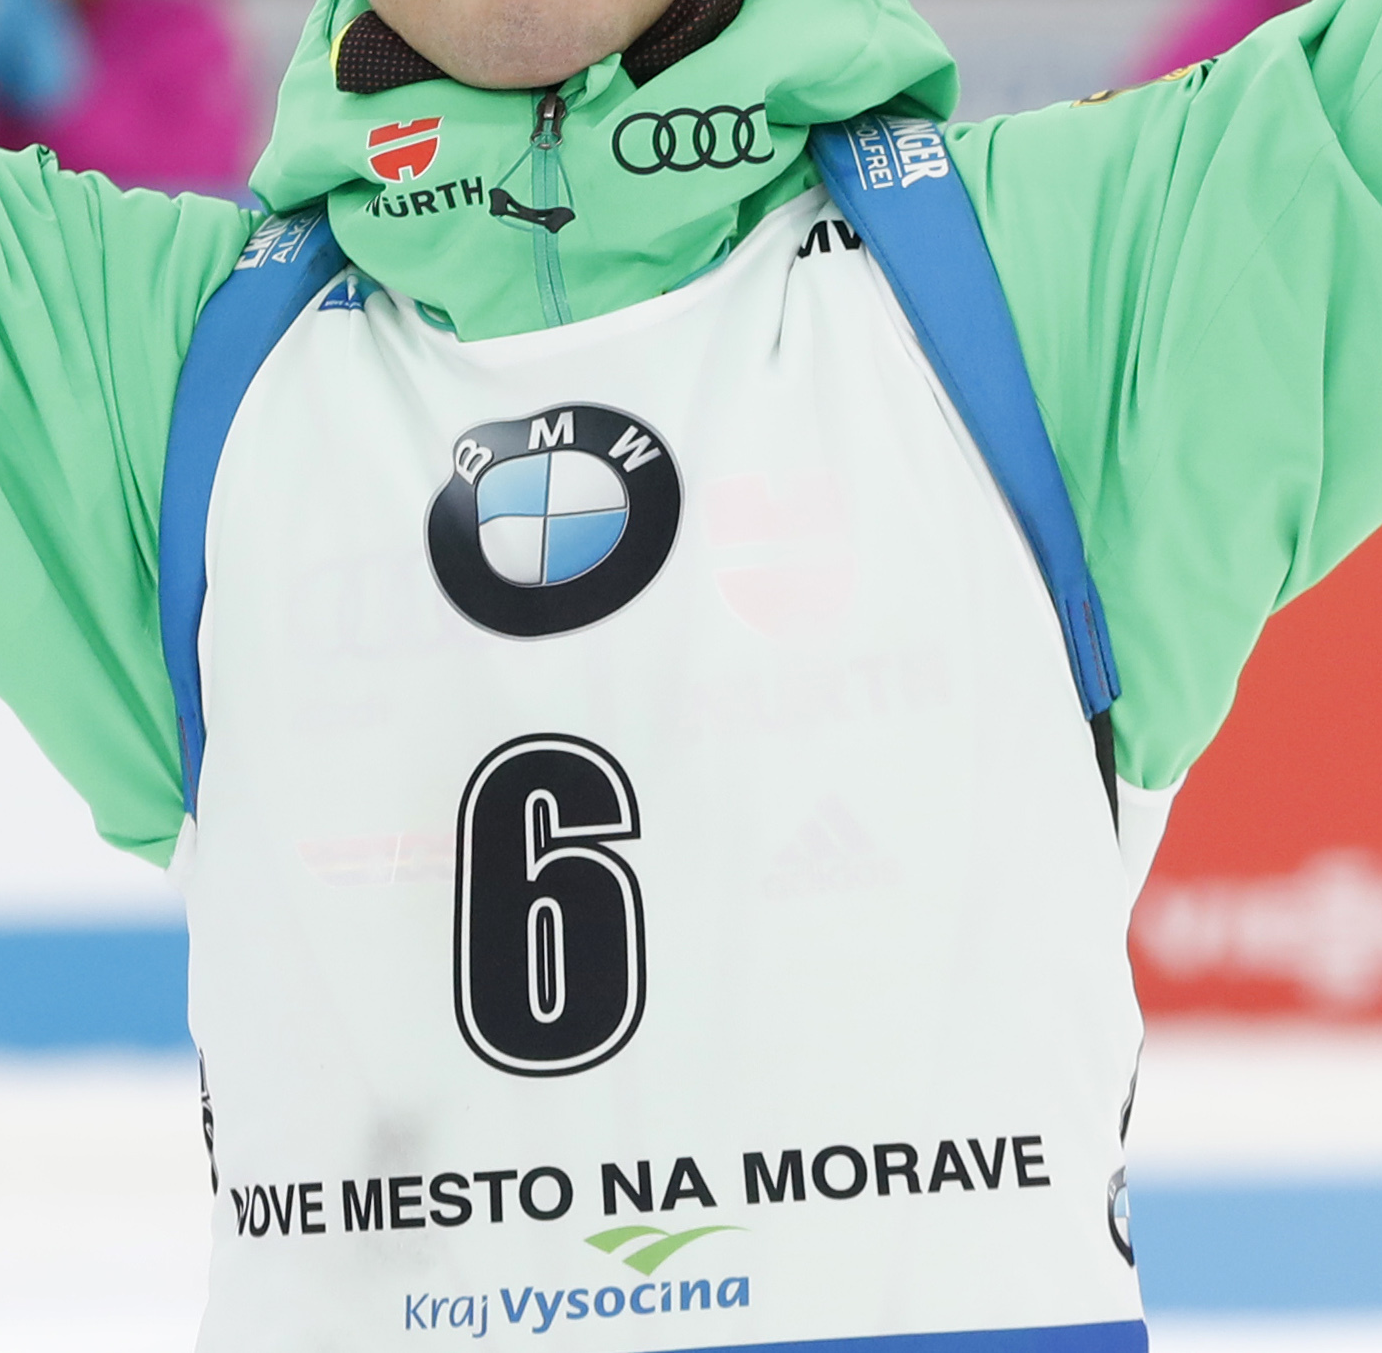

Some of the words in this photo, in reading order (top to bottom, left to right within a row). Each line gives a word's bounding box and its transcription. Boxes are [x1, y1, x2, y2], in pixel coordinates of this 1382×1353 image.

[854, 123, 894, 189] OLFREI
[454, 411, 661, 486] BMW
[453, 731, 647, 1078] 6
[342, 1165, 574, 1232] MESTO
[601, 1155, 717, 1217] NA
[741, 1133, 1052, 1206] MORAVE
[404, 1292, 489, 1339] Kraj
